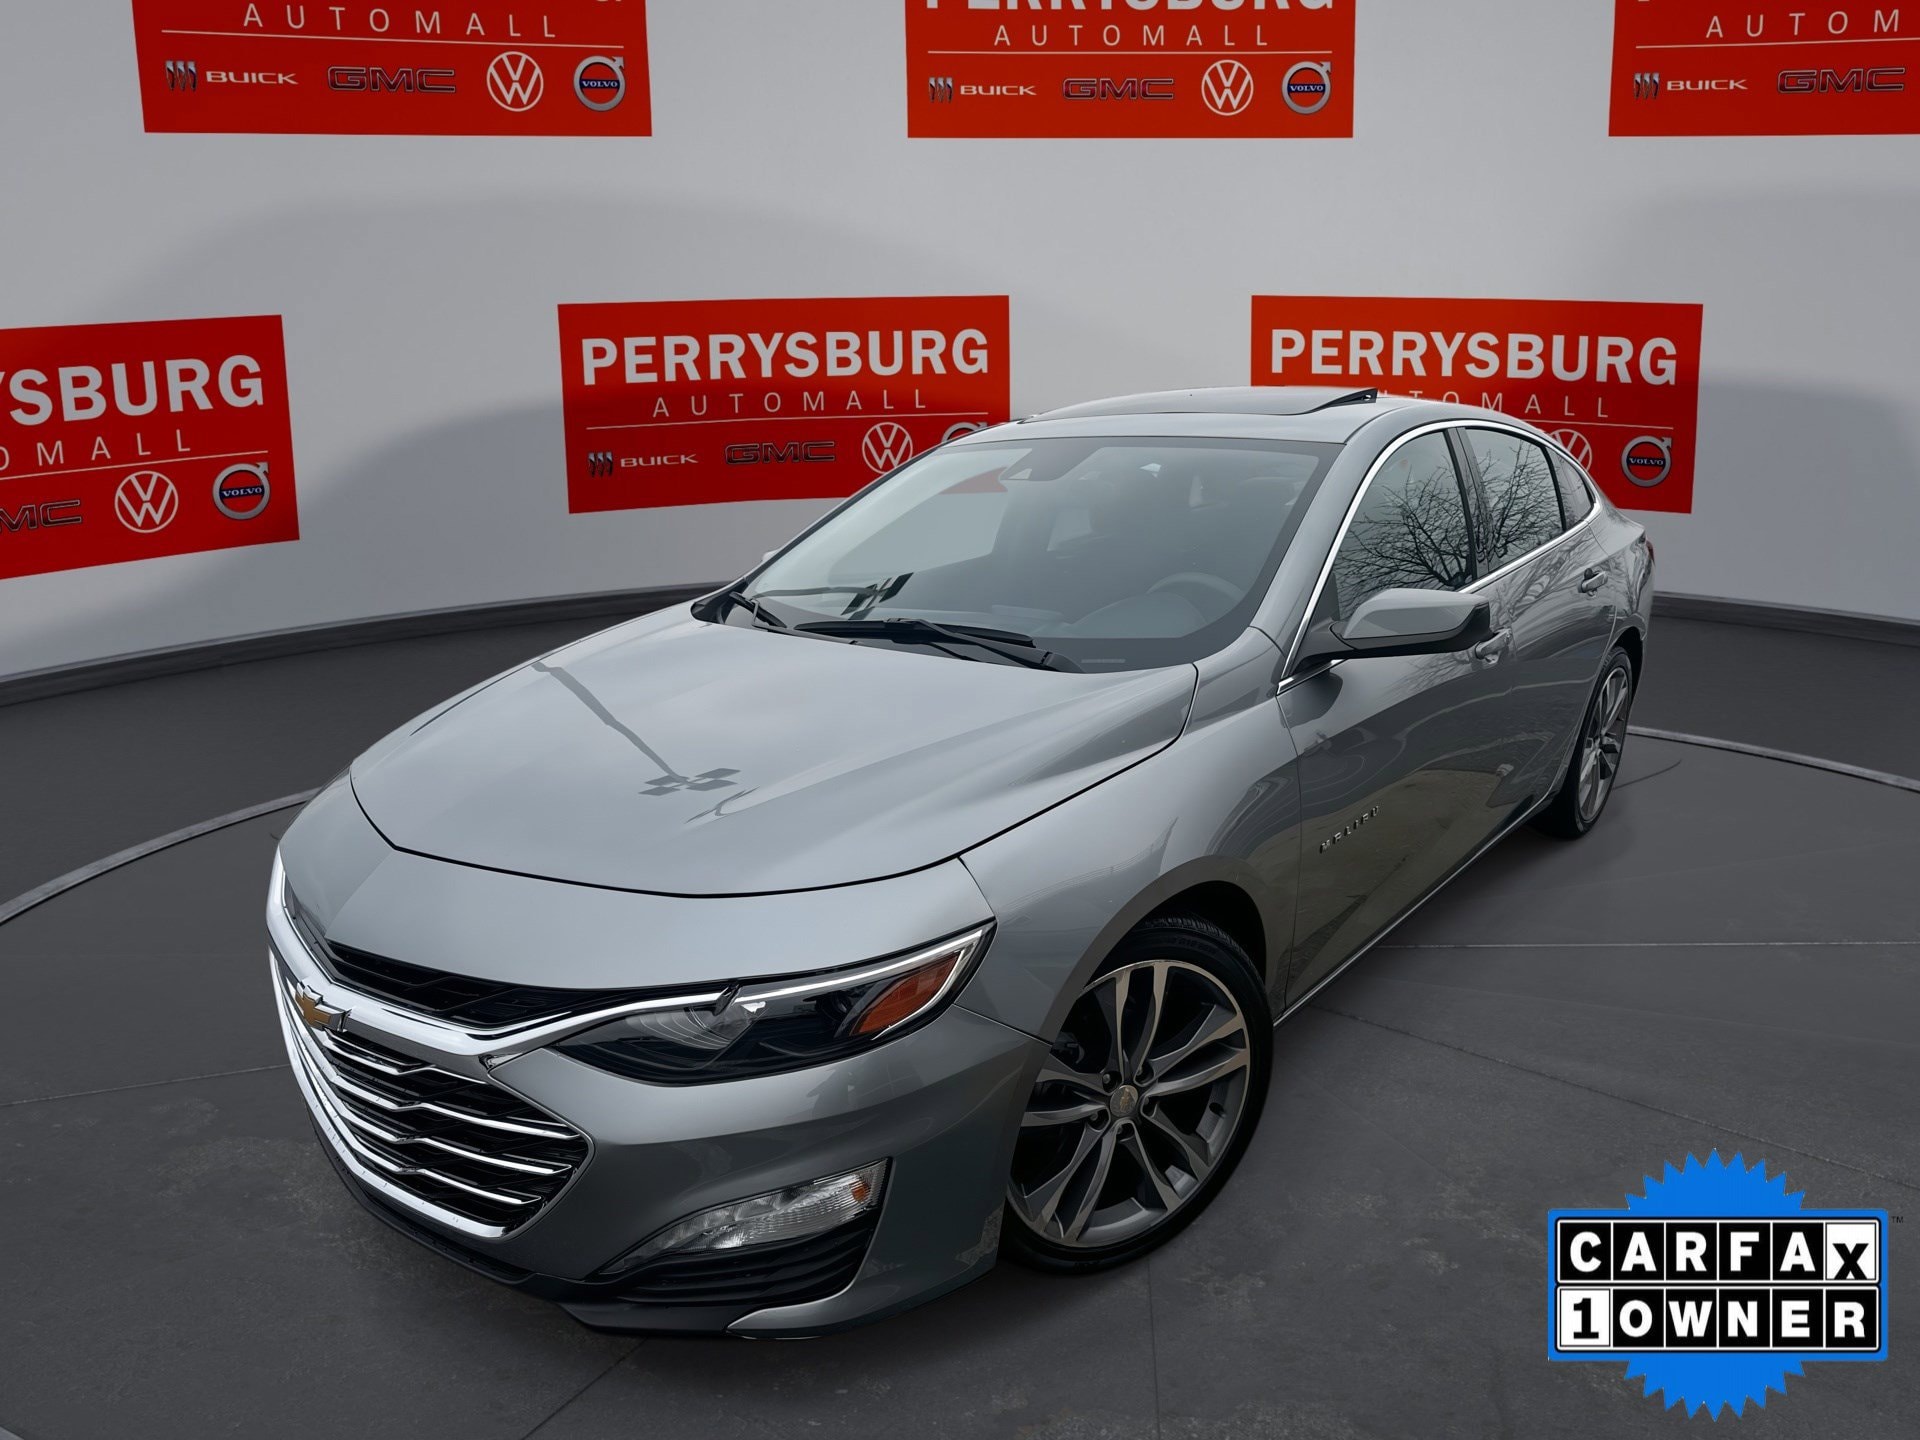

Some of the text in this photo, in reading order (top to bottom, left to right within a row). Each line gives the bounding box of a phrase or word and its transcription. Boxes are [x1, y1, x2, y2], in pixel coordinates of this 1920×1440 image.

[243, 3, 556, 39] AUTOMALL
[994, 24, 1268, 46] AUTOMALL
[1706, 9, 1900, 38] AUTOM
[206, 69, 299, 85] BUICK
[327, 65, 457, 93] GMC
[581, 79, 619, 89] VOLVO
[960, 84, 1037, 96] BUICK
[1062, 77, 1174, 100] GMC
[1289, 83, 1325, 93] VOLVO
[1667, 67, 1905, 94] BUICK GMC
[581, 329, 989, 386] PERRYSBURG
[1271, 329, 1677, 386] PERRYSBURG
[0, 354, 264, 426] SBURG
[652, 389, 926, 418] AUTOMALL
[620, 454, 698, 468] BUICK
[724, 441, 836, 465] GMC
[1628, 457, 1664, 467] VOLVO
[221, 486, 263, 498] VOLVO
